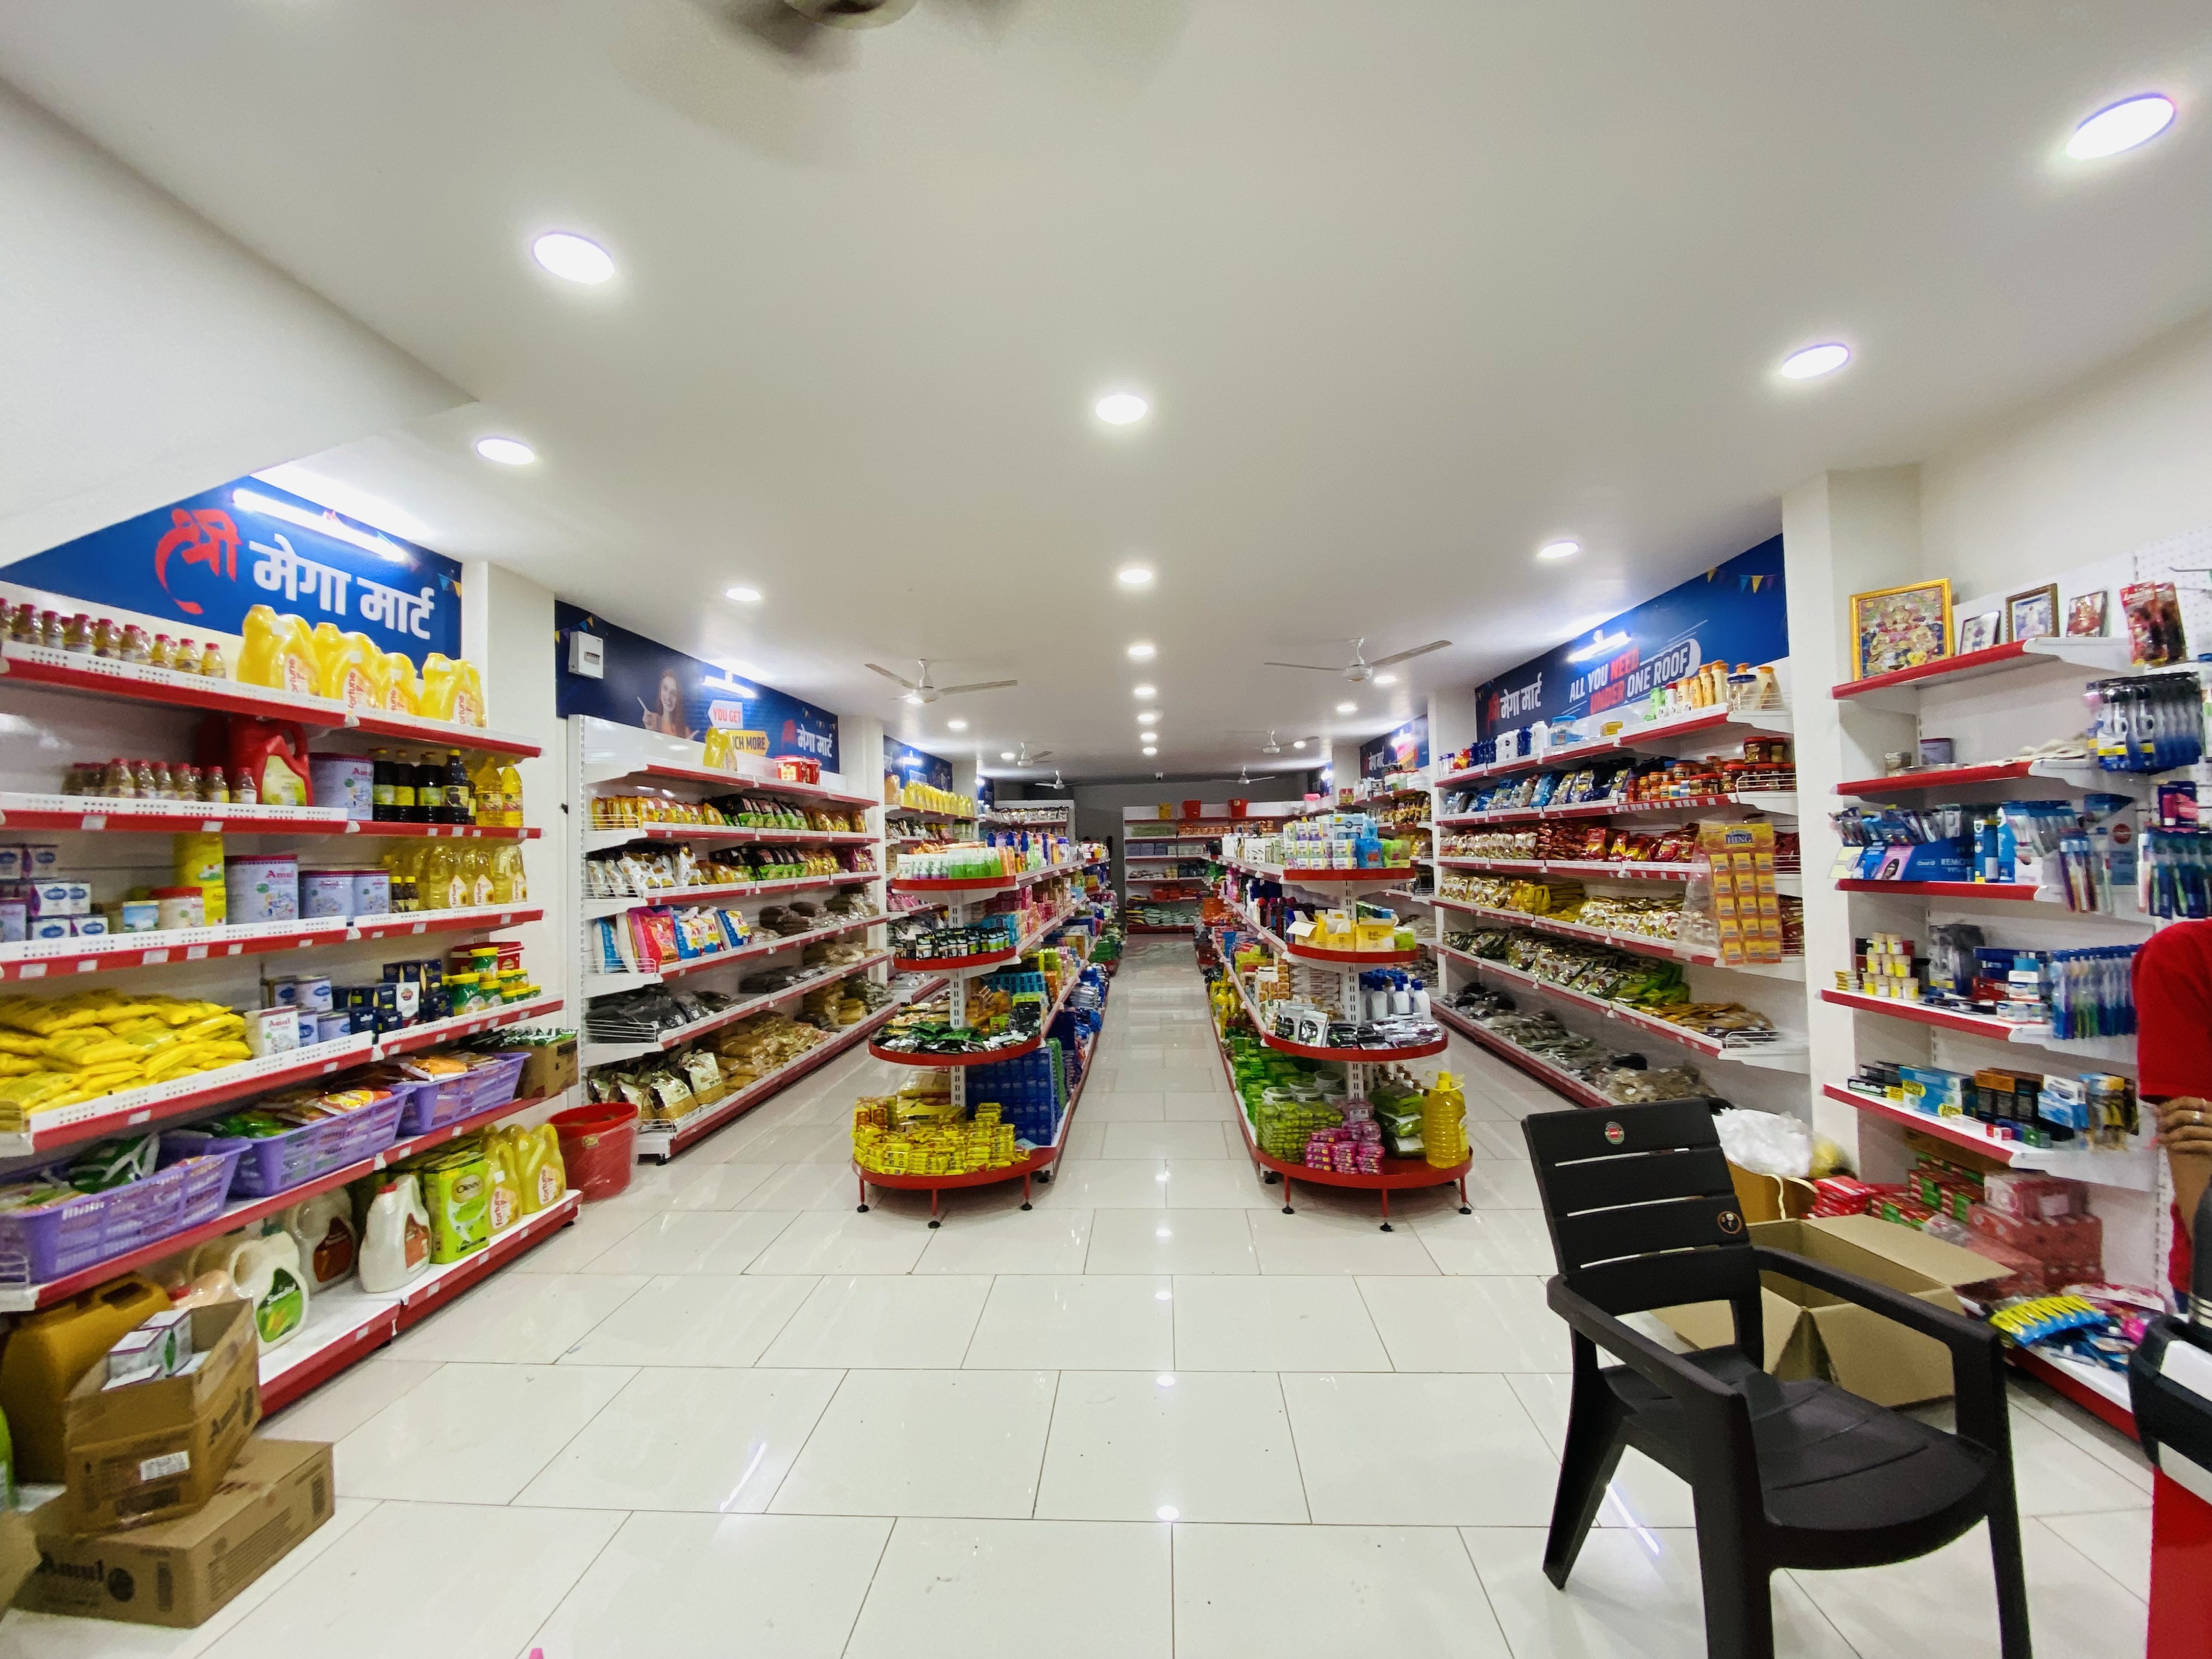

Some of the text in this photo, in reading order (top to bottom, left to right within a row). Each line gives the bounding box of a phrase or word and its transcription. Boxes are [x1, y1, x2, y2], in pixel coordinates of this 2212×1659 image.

[249, 533, 352, 616] मेगा
[356, 576, 435, 641] मार्ट
[288, 658, 298, 693] ortune
[1568, 647, 1639, 703] ALL YOU NEED
[1627, 668, 1650, 698] ONE
[1654, 646, 1689, 685] ROOF
[348, 672, 357, 709] fortune
[1499, 688, 1520, 719] मेगा
[1520, 672, 1542, 710] मार्ट
[713, 708, 741, 723] YOU GET
[746, 735, 766, 751] MORE
[797, 723, 815, 753] मेगा
[816, 733, 833, 758] मार्ट
[1726, 835, 1751, 844] HING
[269, 1018, 290, 1027] Amul
